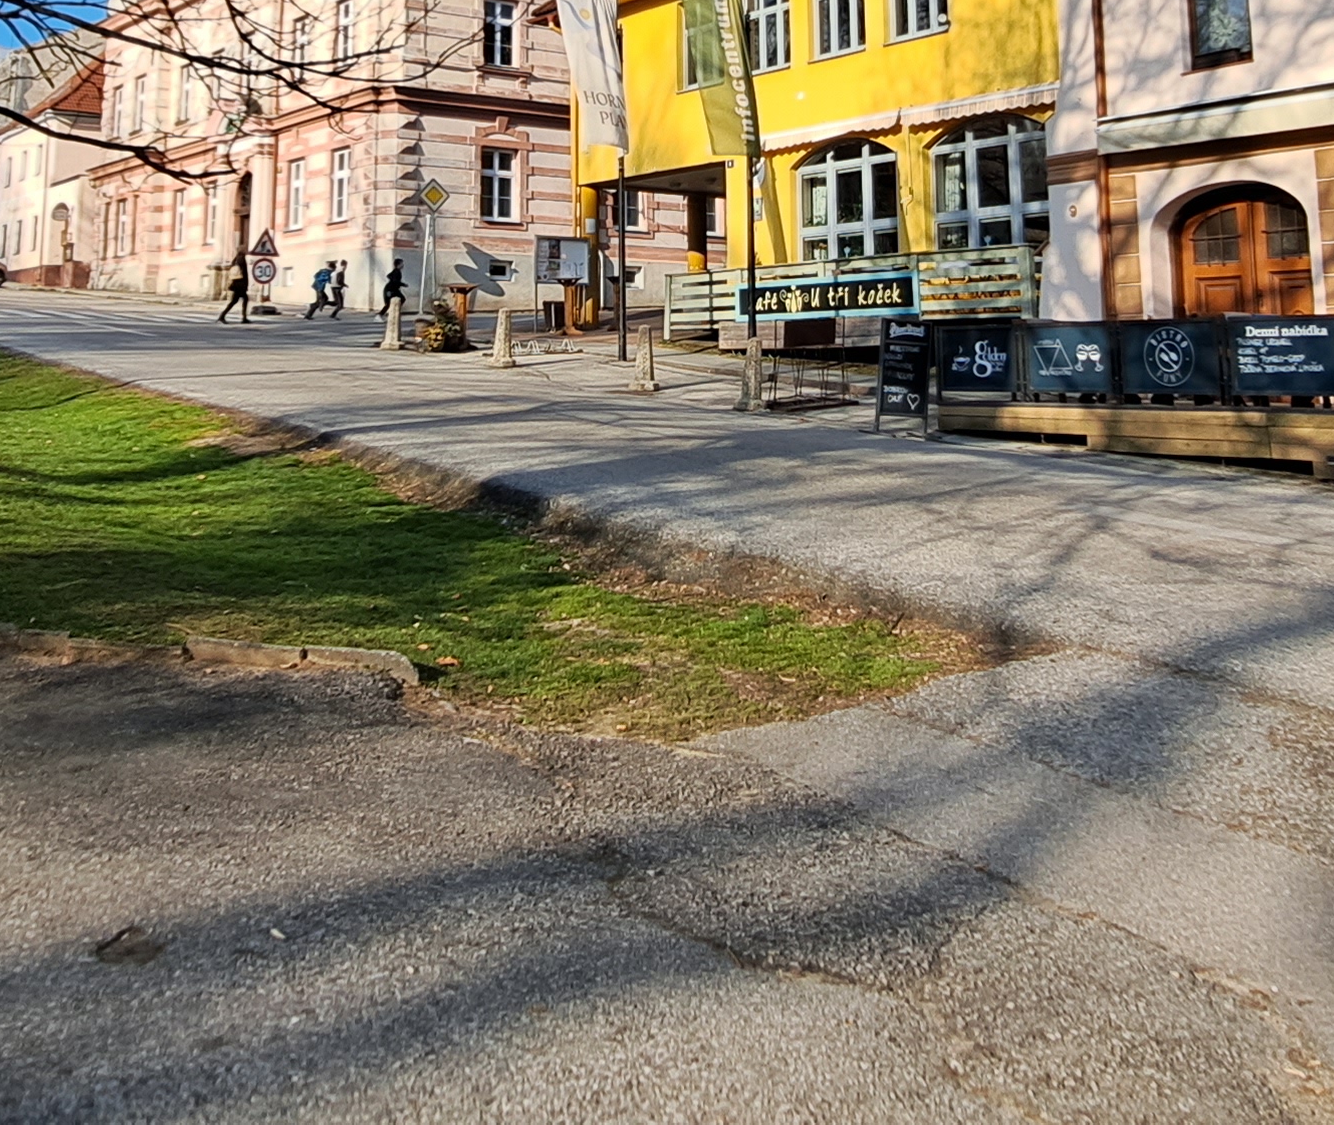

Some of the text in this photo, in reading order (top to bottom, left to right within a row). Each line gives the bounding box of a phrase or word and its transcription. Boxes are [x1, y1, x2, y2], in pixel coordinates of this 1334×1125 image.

[256, 265, 272, 278] 30
[753, 291, 778, 311] afé
[810, 287, 820, 308] U
[857, 282, 902, 306] koček
[1150, 330, 1188, 348] BISTRO
